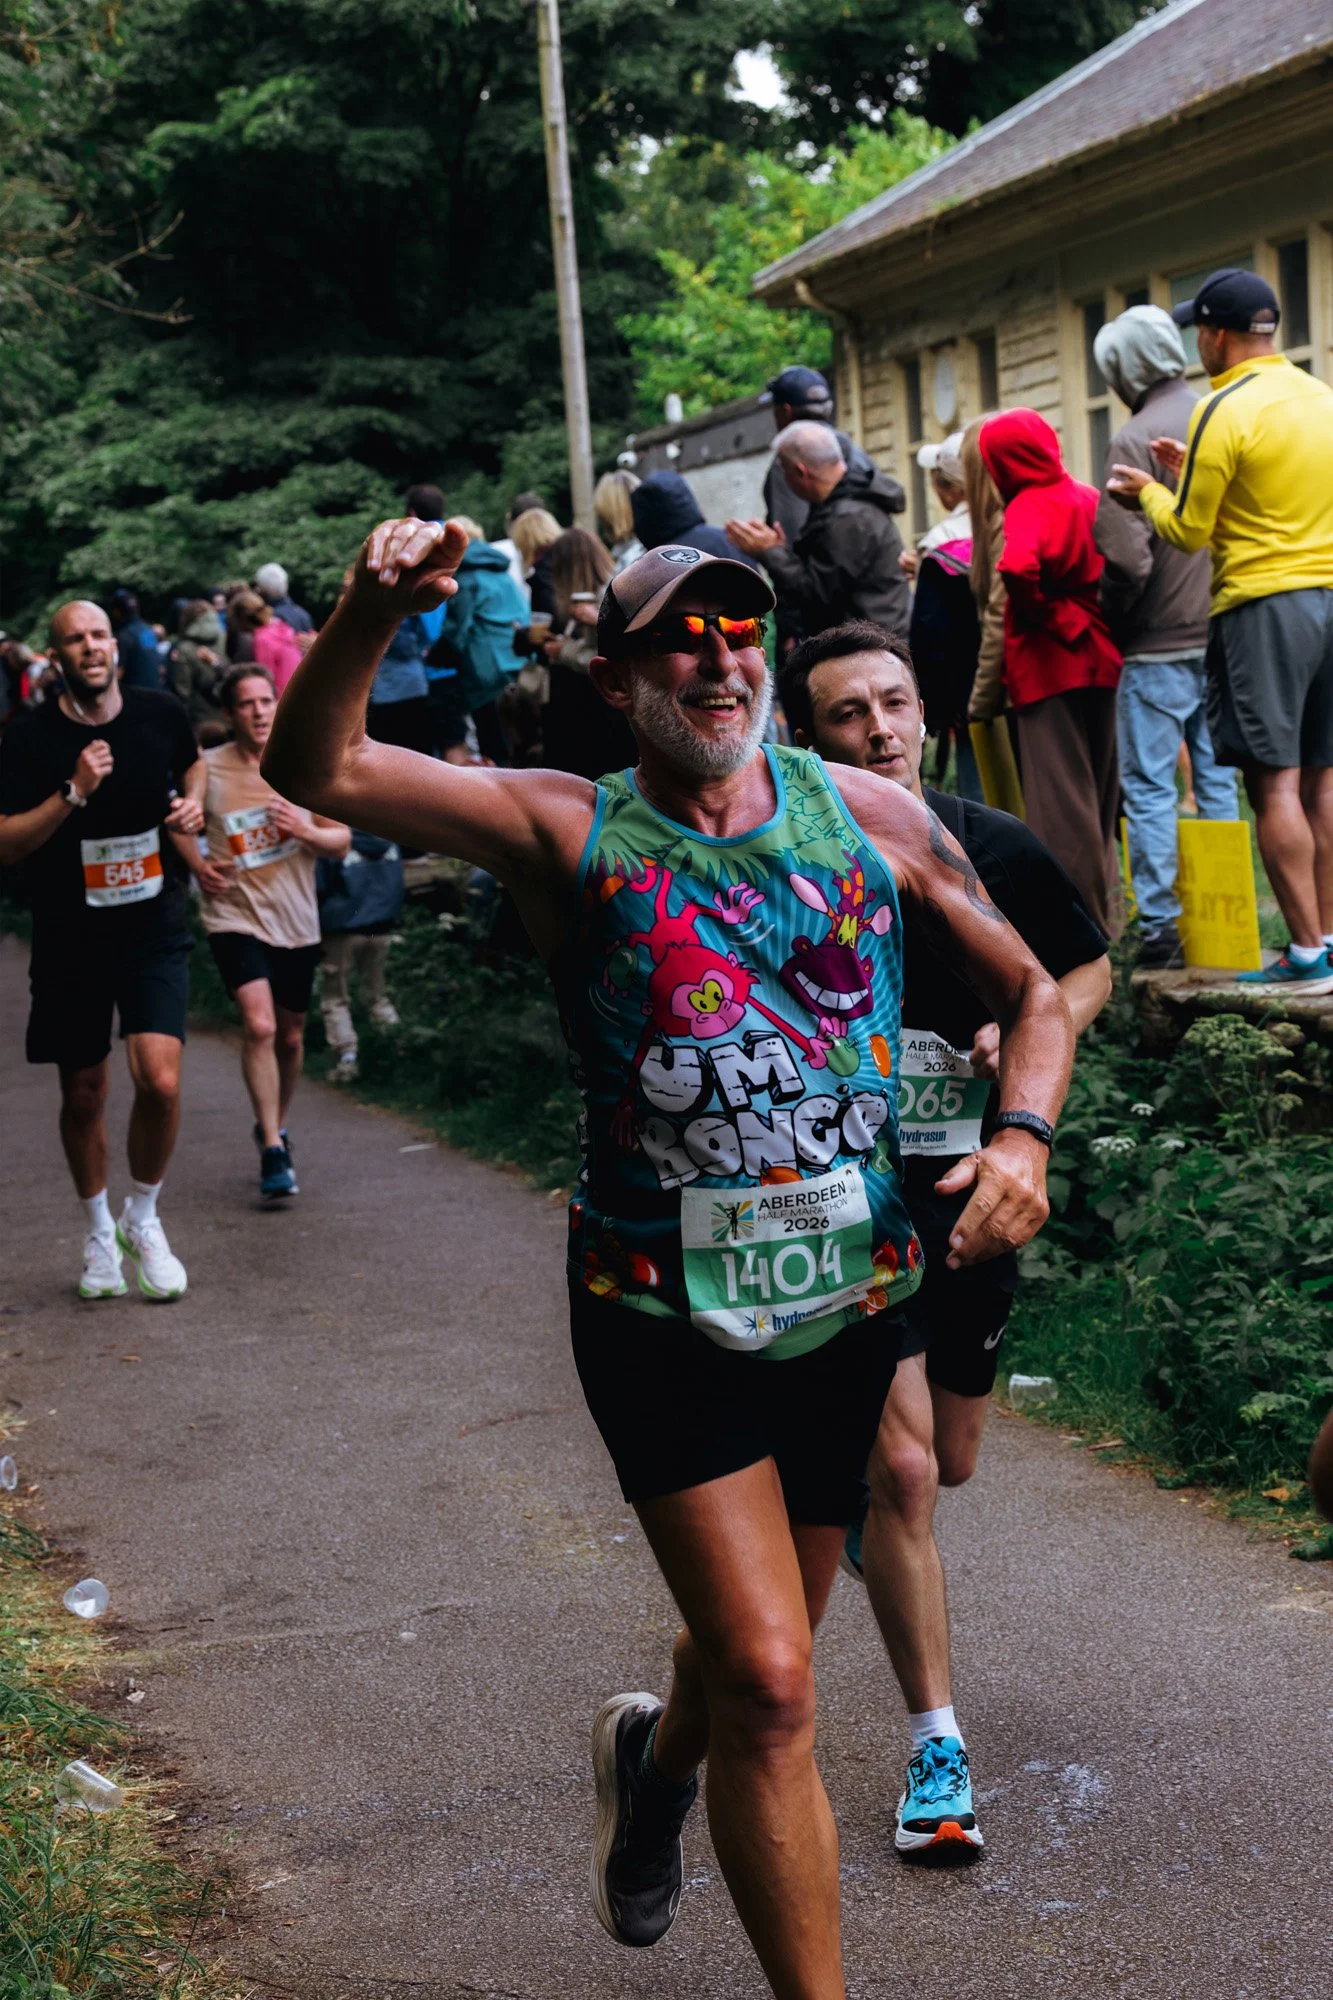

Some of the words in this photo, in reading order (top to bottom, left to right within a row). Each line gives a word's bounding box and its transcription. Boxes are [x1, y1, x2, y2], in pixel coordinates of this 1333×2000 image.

[908, 1040, 958, 1055] ABERD
[638, 1036, 805, 1113] UM
[924, 1062, 957, 1072] 2026
[899, 1129, 946, 1143] hydrasun
[758, 1180, 847, 1213] ABERDEEN
[757, 1208, 788, 1222] HALF
[790, 1197, 849, 1216] MARATHON
[784, 1216, 830, 1232] 2026
[721, 1238, 844, 1302] 1404
